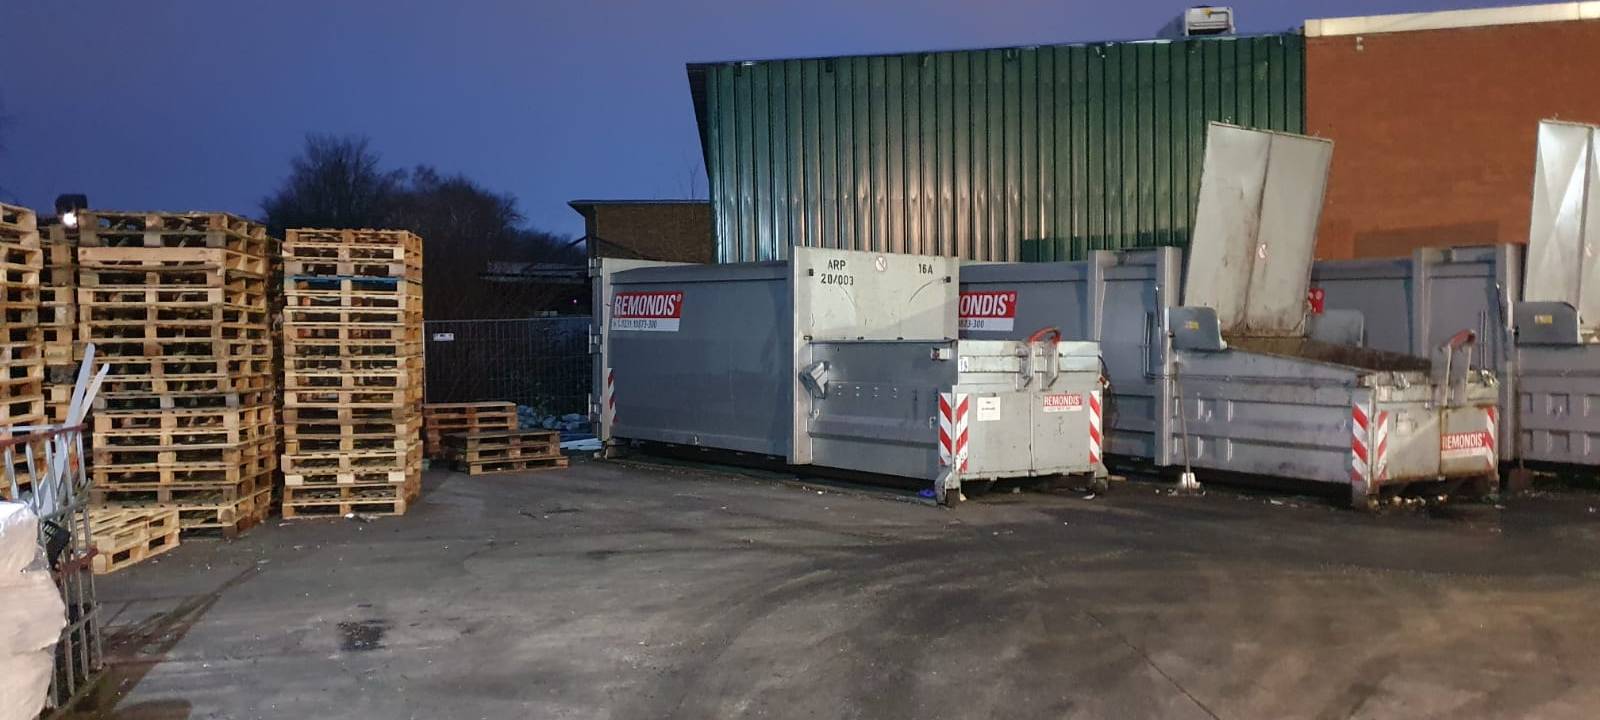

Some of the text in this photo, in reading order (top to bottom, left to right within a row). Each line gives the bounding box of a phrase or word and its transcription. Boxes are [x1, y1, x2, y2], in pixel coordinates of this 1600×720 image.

[828, 260, 846, 271] ARP
[919, 263, 933, 275] 16A
[820, 274, 854, 286] 20/003
